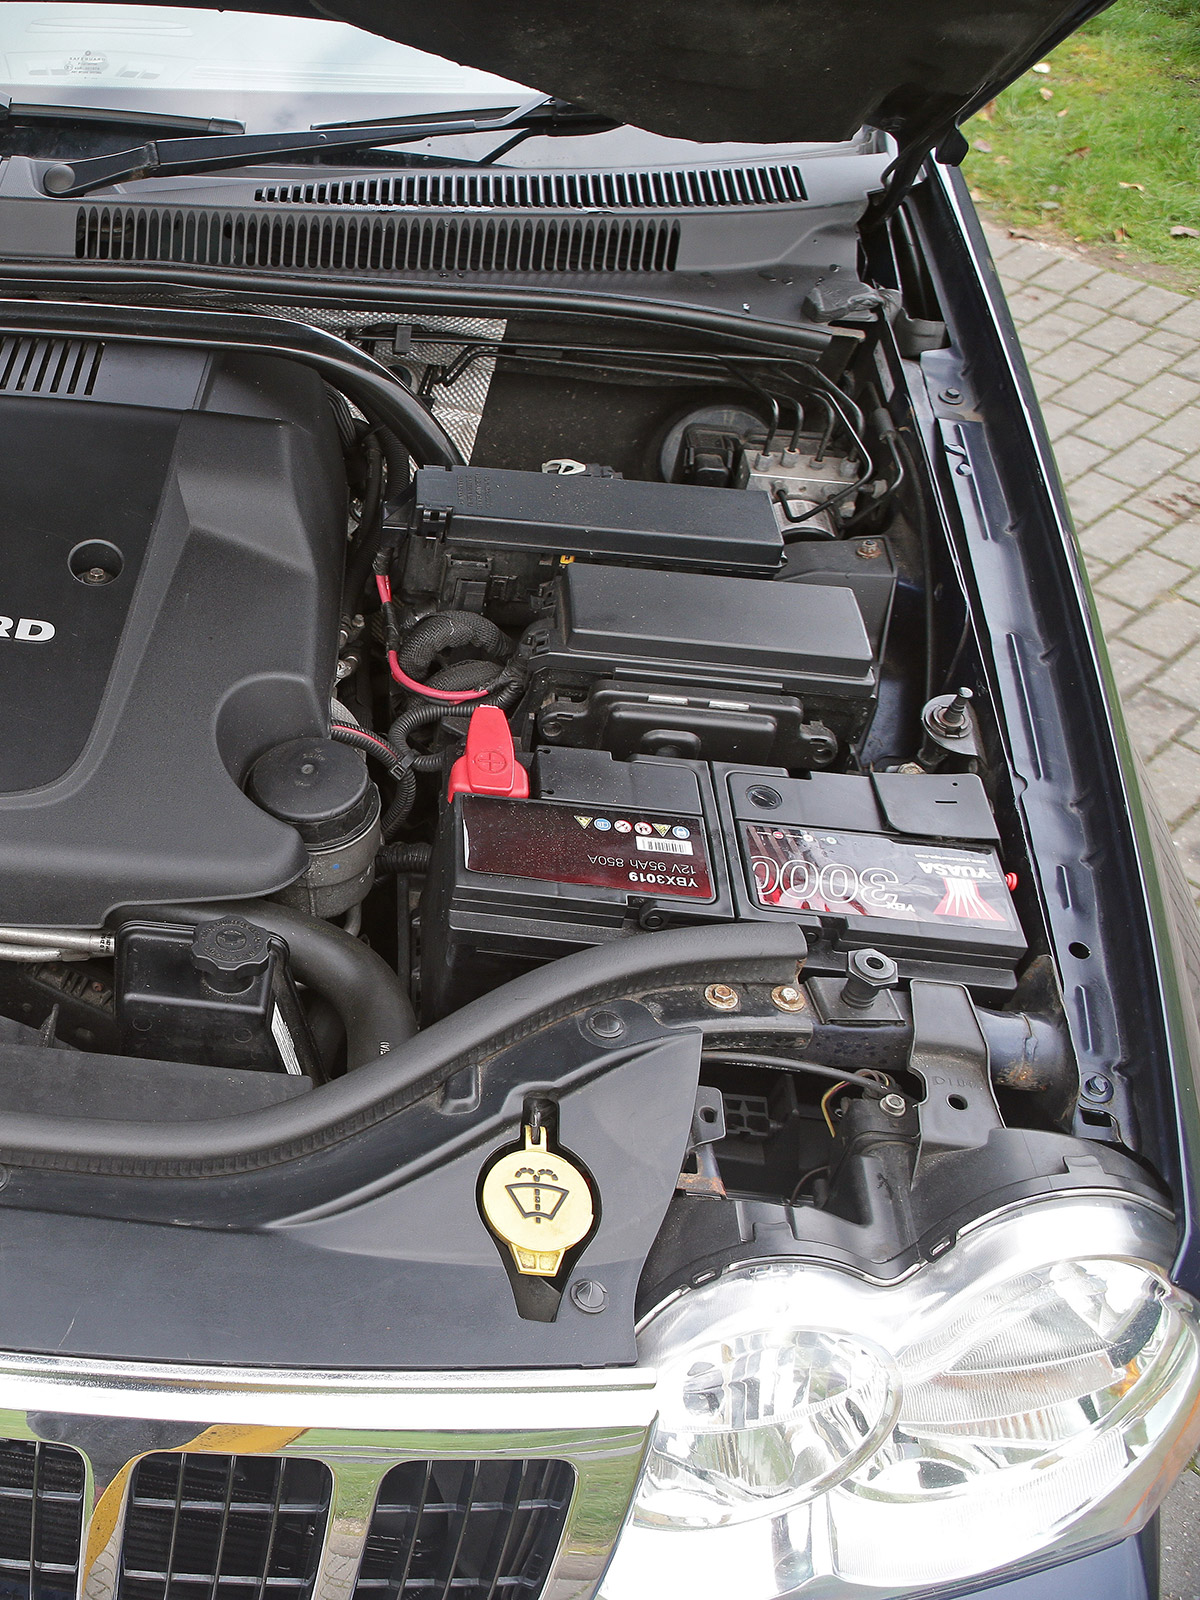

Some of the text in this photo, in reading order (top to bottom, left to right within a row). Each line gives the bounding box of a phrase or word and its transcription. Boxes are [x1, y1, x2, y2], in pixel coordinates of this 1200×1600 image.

[587, 854, 697, 876] 12V 95Ah 850A
[916, 860, 993, 881] YUASA
[628, 871, 699, 888] YBX3019
[885, 900, 917, 913] YBX
